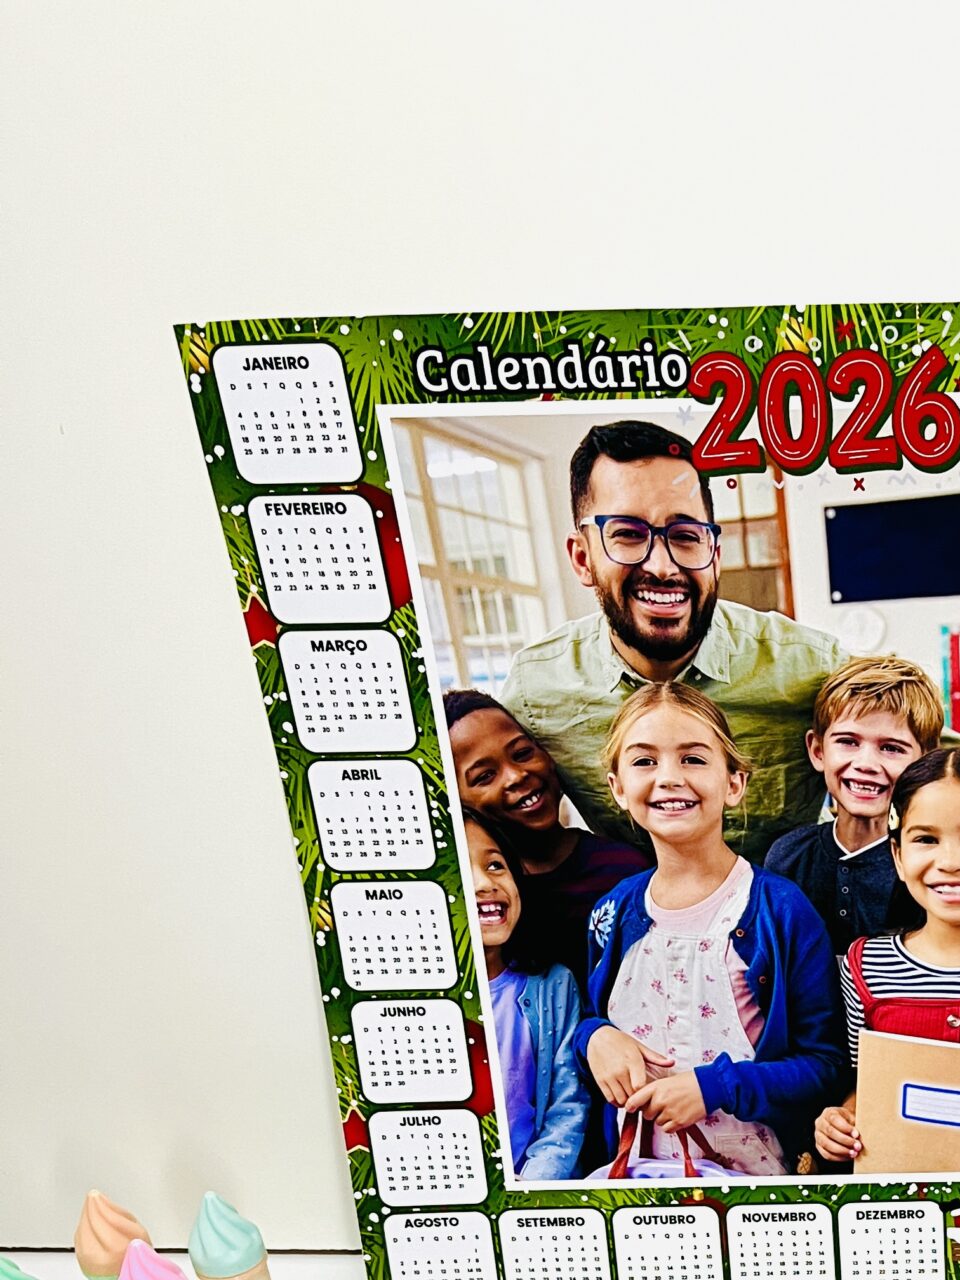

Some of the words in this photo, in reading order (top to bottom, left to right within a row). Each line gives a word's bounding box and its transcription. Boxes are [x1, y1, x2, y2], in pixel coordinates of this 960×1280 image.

[242, 355, 310, 372] JANEIRO
[413, 338, 689, 395] Calendário
[263, 501, 348, 517] FEVEREIRO
[309, 639, 368, 656] MARÇO
[341, 768, 383, 782] ABRIL
[364, 888, 404, 901] MAIO
[379, 1005, 427, 1018] JUNHO
[399, 1115, 442, 1127] JULHO
[632, 1214, 696, 1226] OUTUBRO
[741, 1211, 817, 1224] NOVEMBRO
[855, 1209, 926, 1221] DEZEMBRO
[404, 1216, 460, 1229] AGOSTO
[516, 1216, 586, 1228] SETEMBRO
